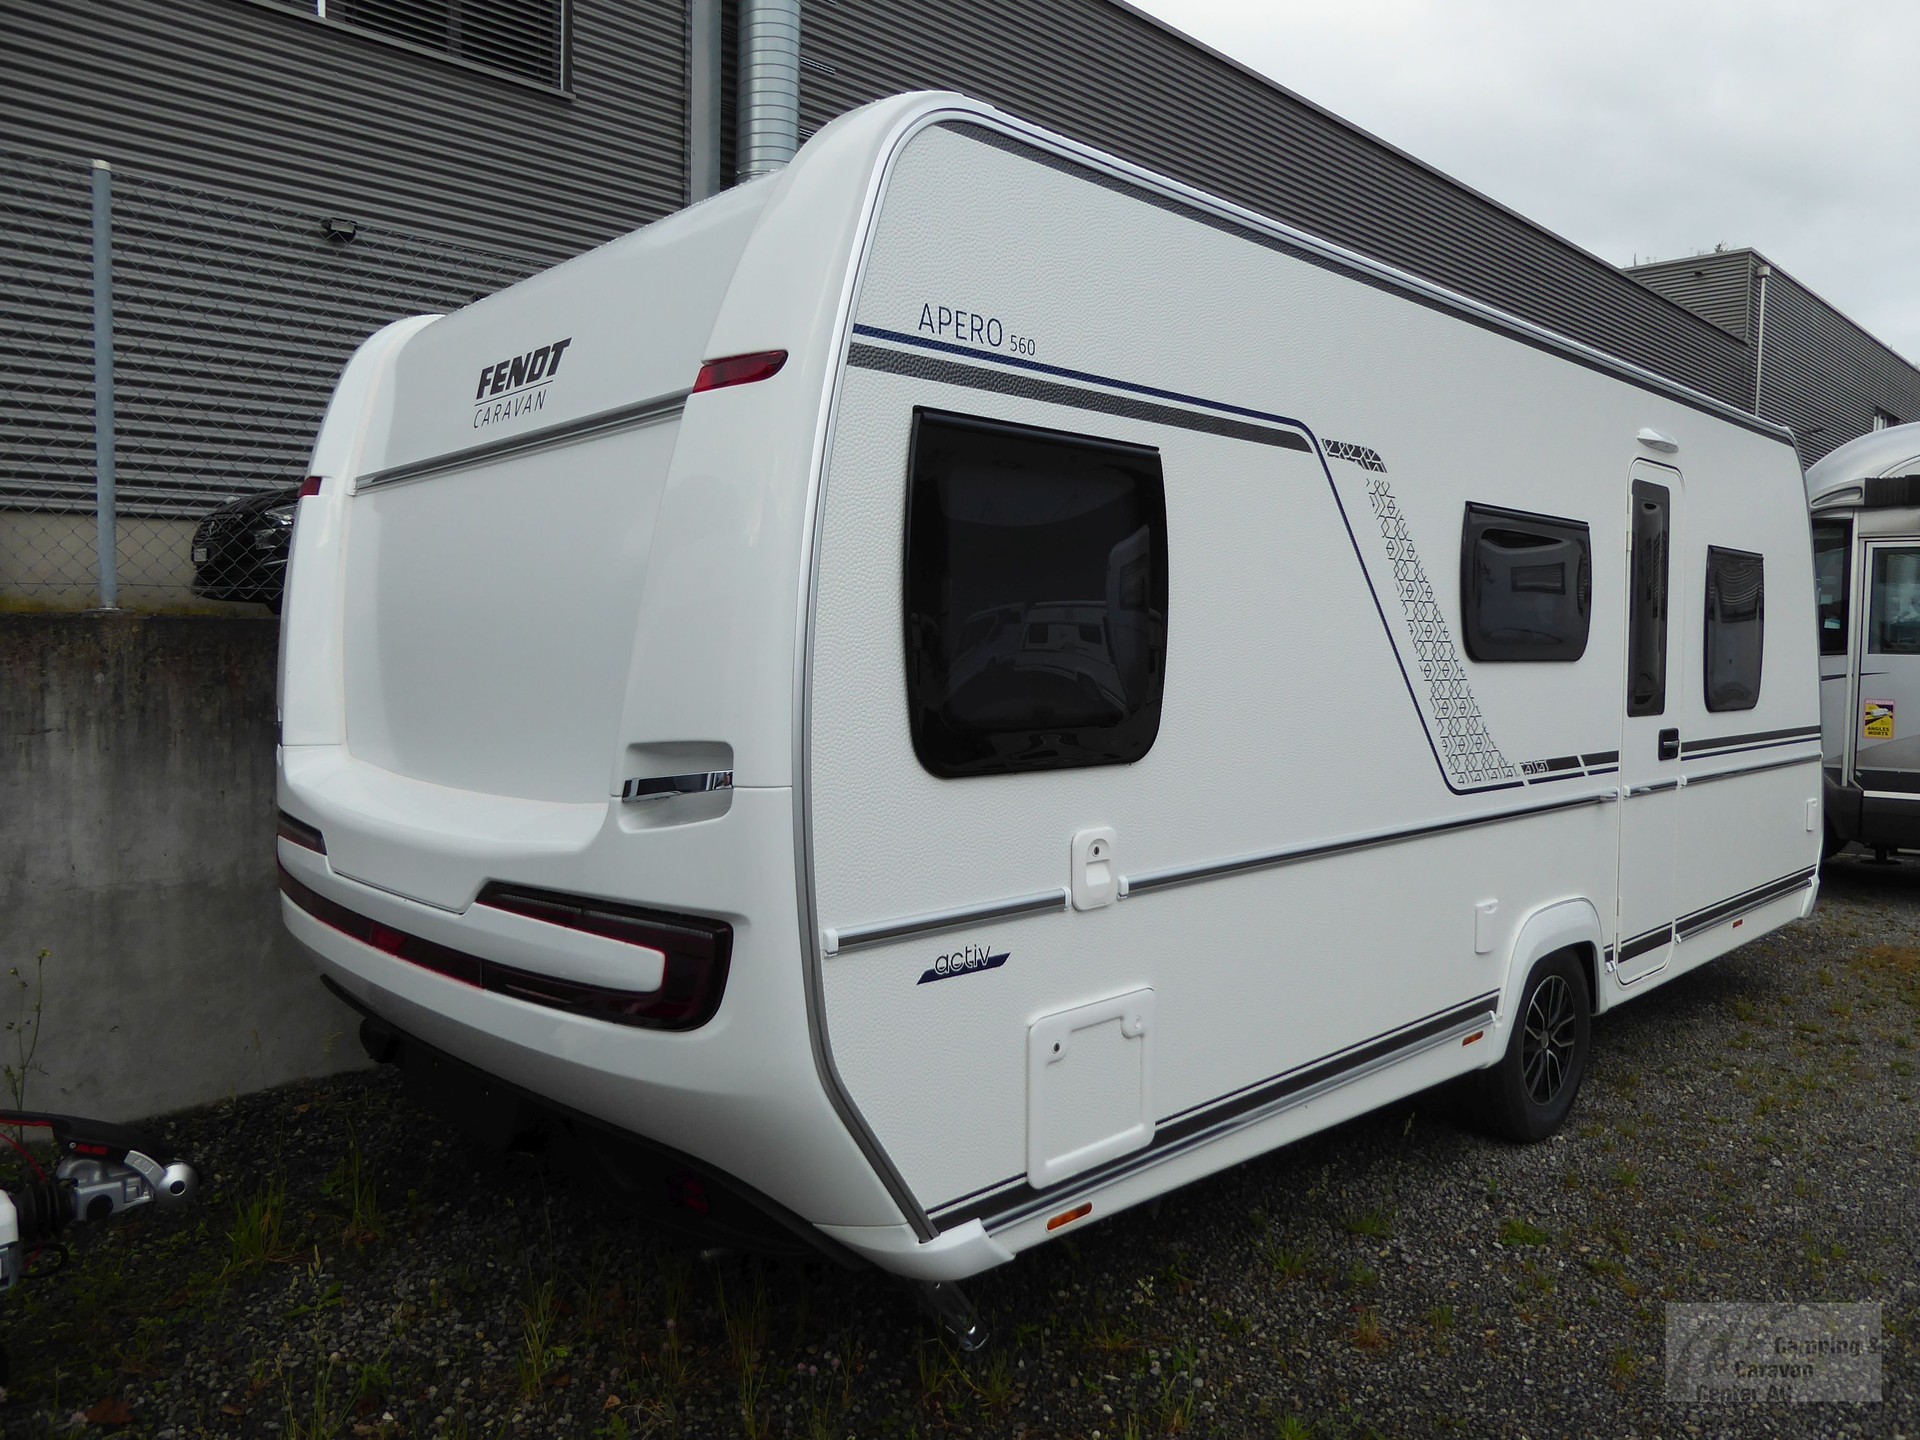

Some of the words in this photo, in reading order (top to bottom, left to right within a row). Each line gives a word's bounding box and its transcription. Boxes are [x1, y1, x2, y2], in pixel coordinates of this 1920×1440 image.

[918, 302, 1003, 347] APERO
[1010, 334, 1036, 356] 560
[476, 337, 573, 400] FENDT
[473, 389, 547, 429] CARAVAN
[934, 943, 991, 975] activ
